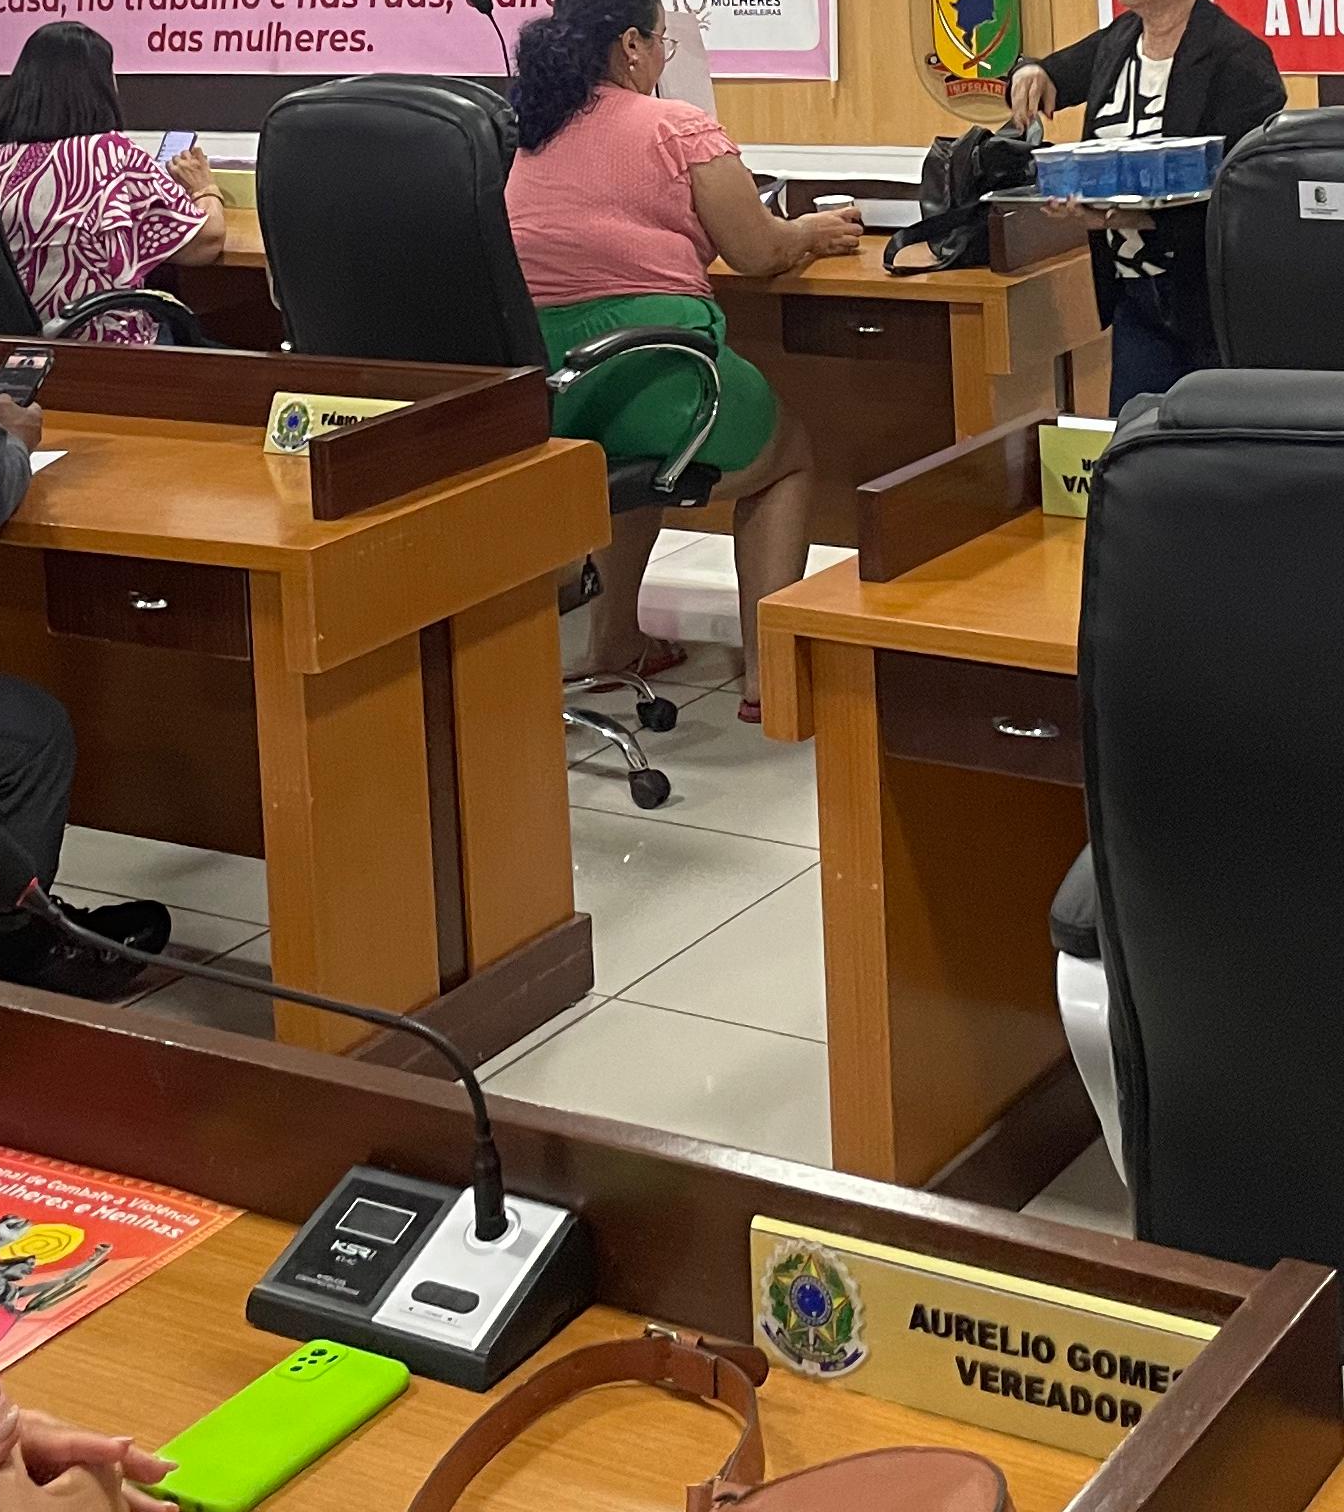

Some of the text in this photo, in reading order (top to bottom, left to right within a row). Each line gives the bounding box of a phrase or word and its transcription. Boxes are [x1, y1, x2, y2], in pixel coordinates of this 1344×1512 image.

[733, 9, 782, 17] BRASILEIRAS
[147, 21, 375, 53] das mulheres.
[947, 81, 1004, 96] IMPERATR
[27, 1171, 47, 1186] de
[46, 1178, 113, 1204] Combate
[130, 1196, 201, 1227] Violência
[73, 1201, 92, 1216] e
[89, 1204, 185, 1239] Meninas
[908, 1303, 1056, 1365] AURELIO
[955, 1355, 1143, 1429] VEREADOR
